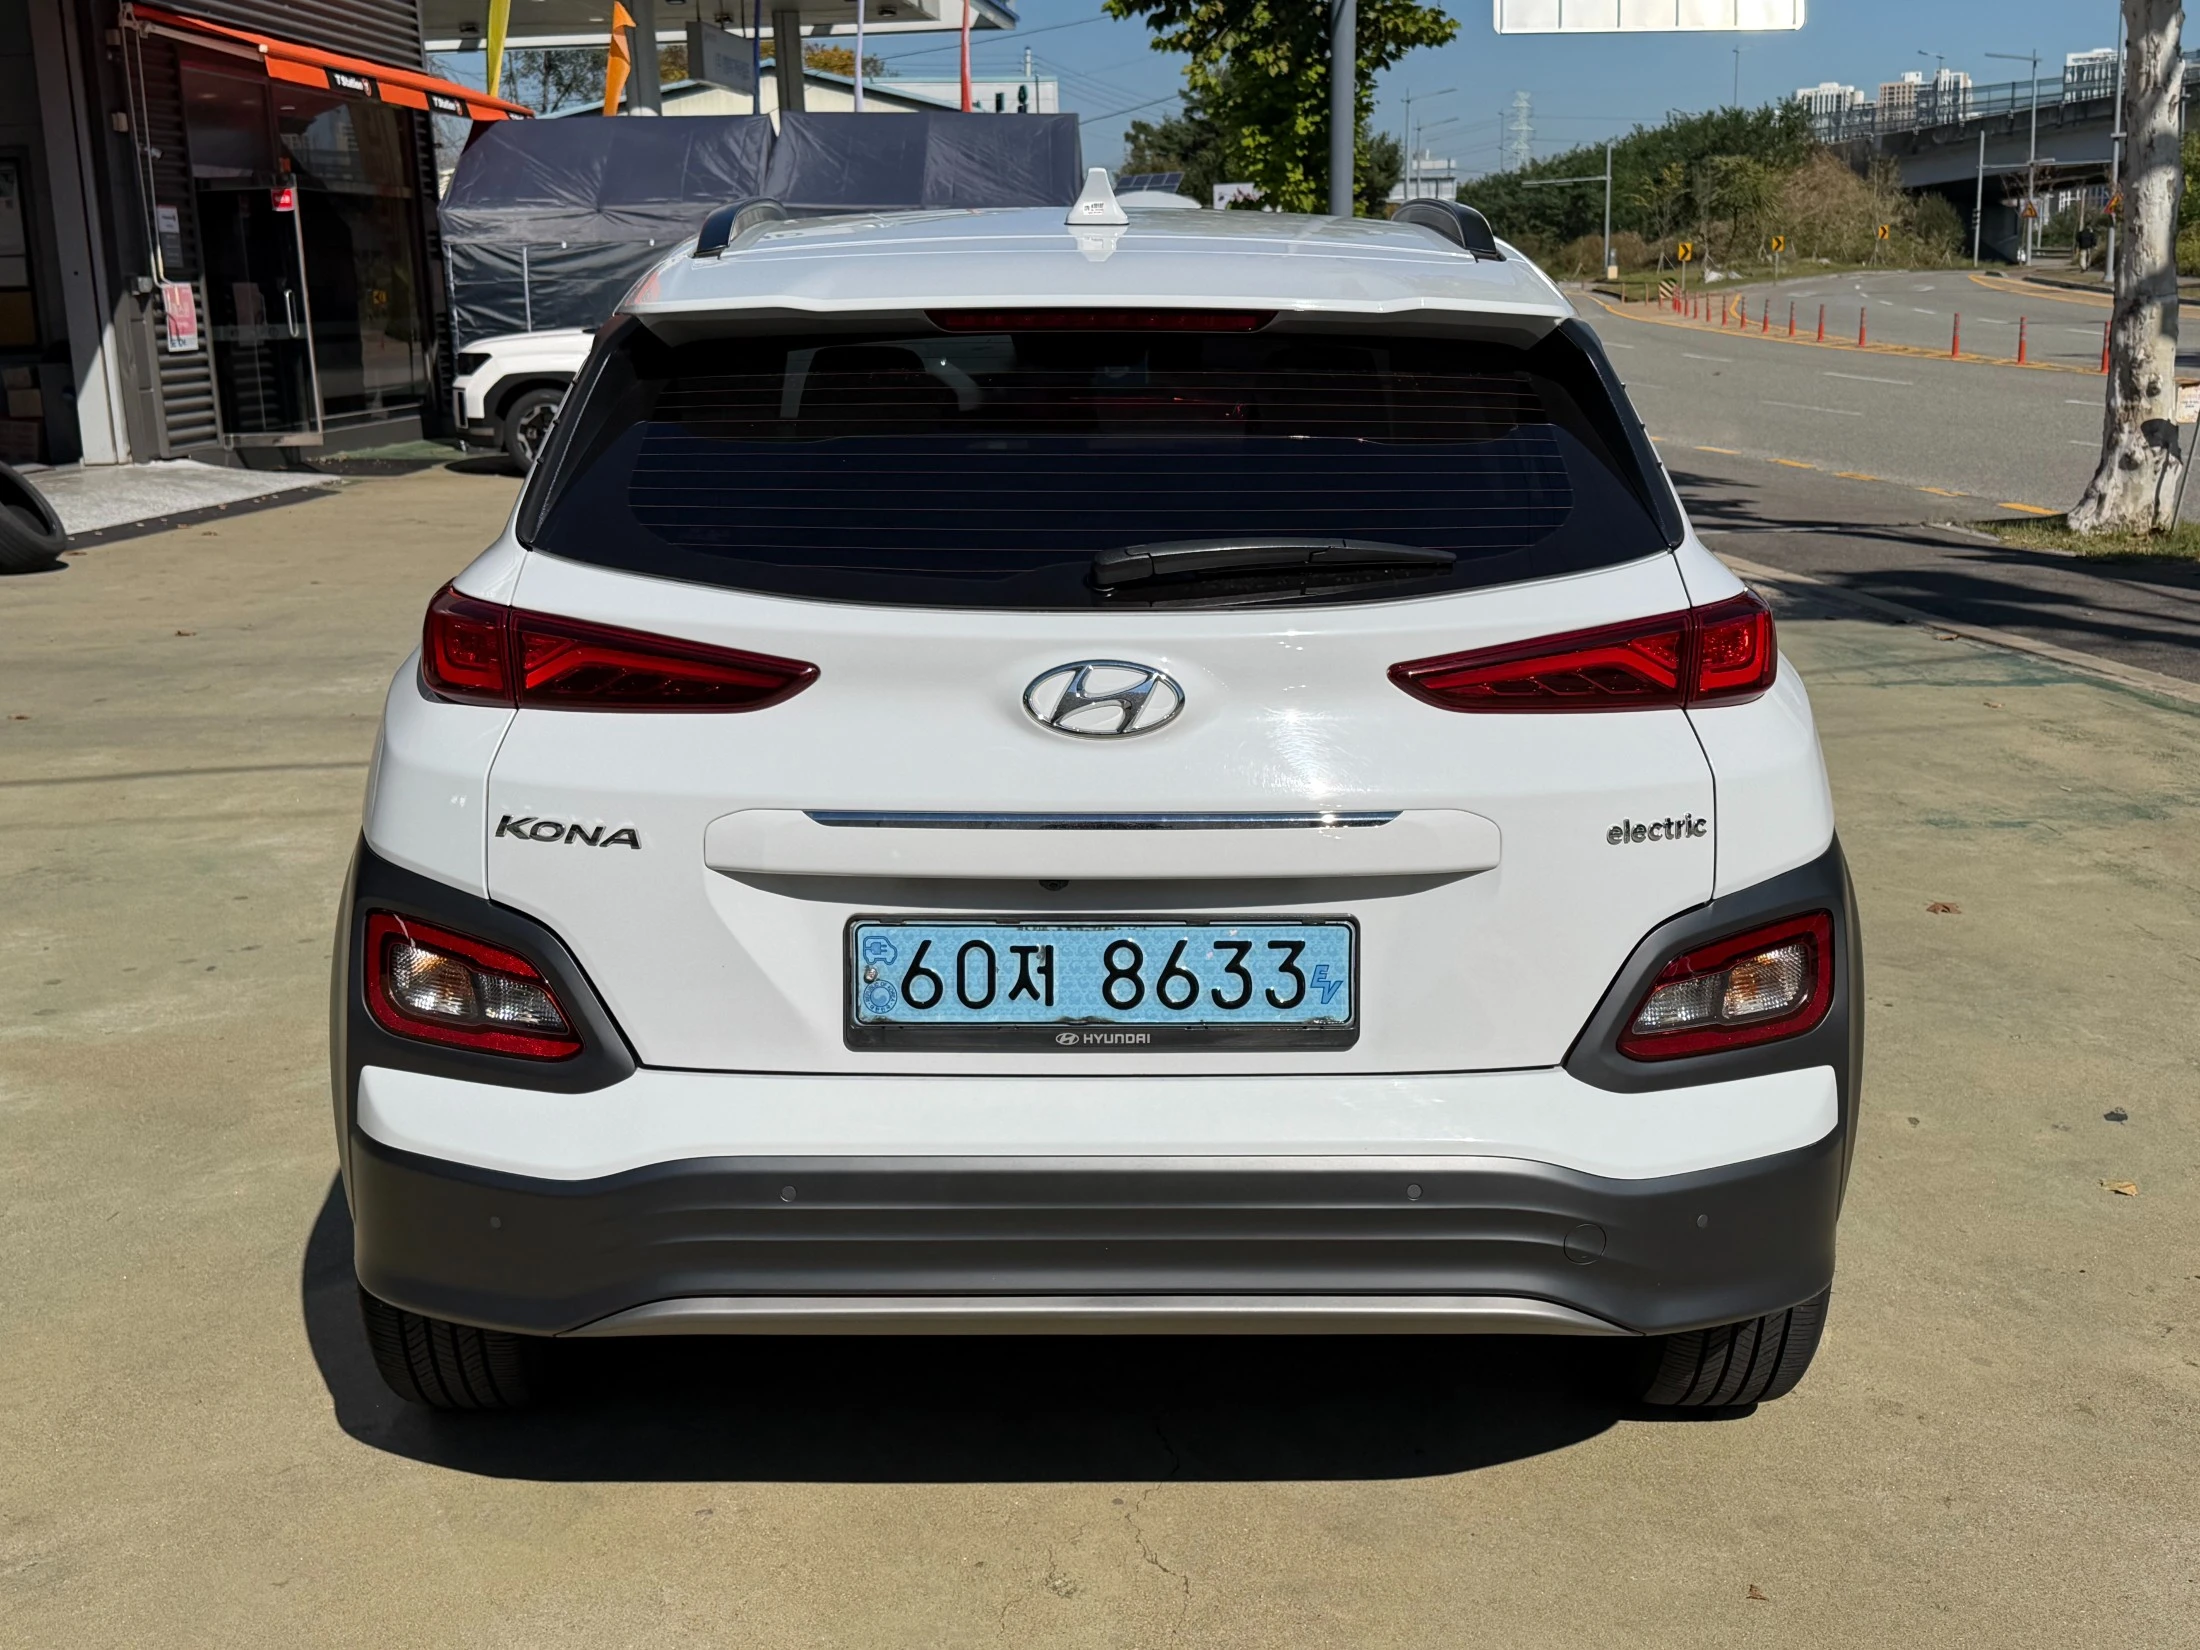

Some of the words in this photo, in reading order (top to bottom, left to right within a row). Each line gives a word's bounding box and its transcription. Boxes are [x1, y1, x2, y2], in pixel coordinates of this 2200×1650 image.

[495, 814, 642, 850] KONA
[1606, 812, 1707, 845] electric
[901, 939, 1055, 1010] 60저
[1101, 939, 1306, 1010] 8633
[1310, 964, 1343, 1004] EV
[1083, 1033, 1151, 1044] HYUNDAI
